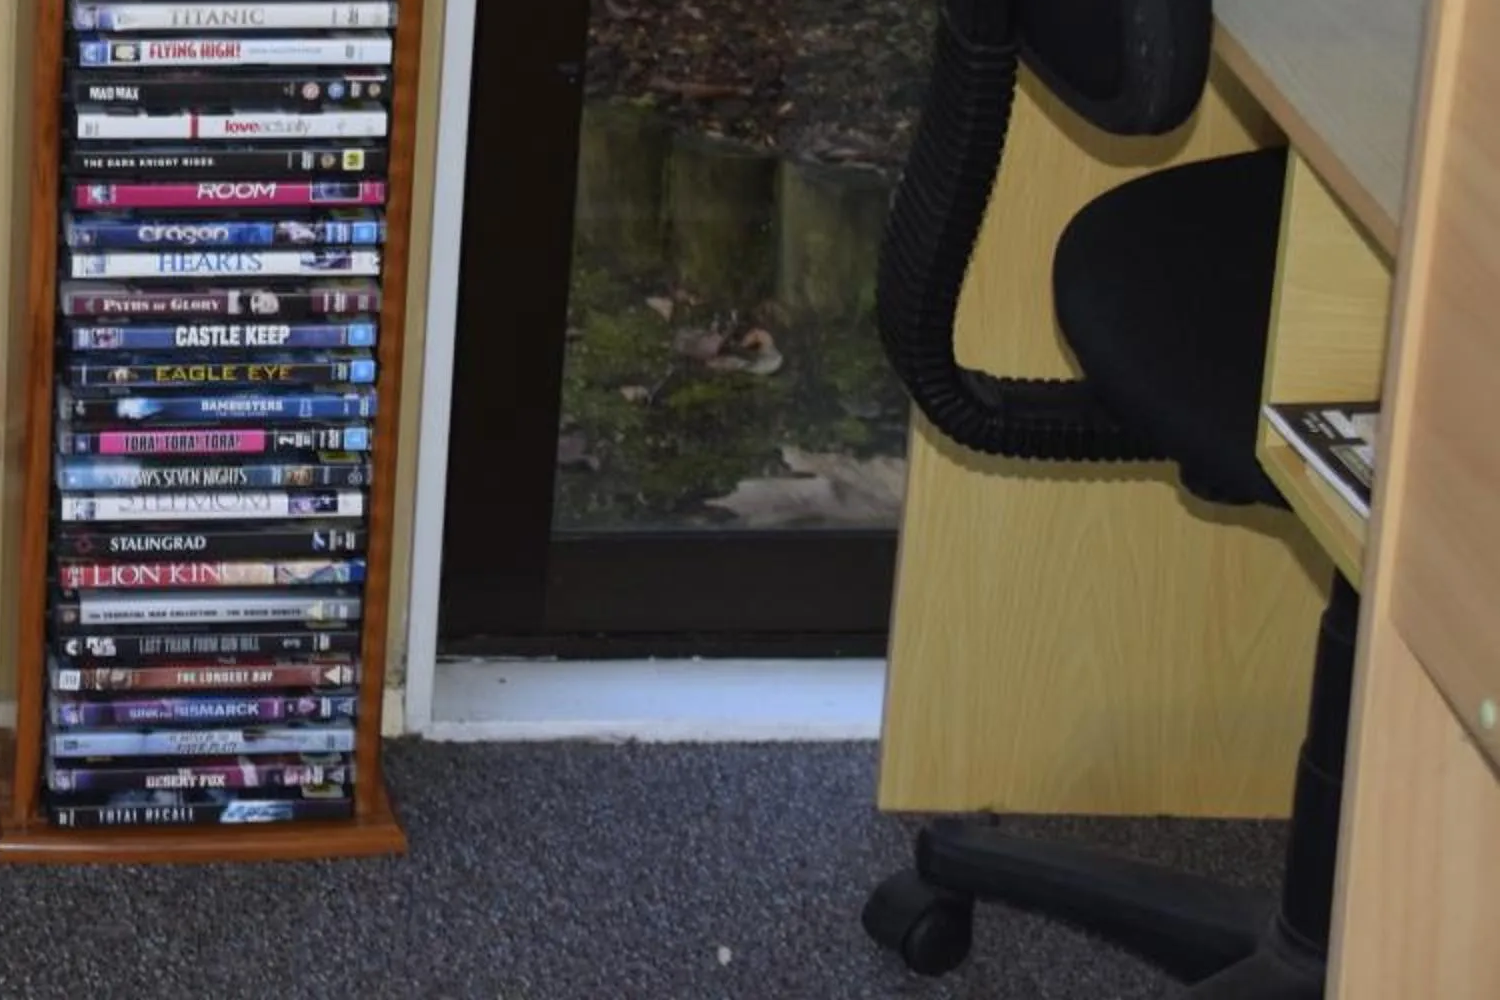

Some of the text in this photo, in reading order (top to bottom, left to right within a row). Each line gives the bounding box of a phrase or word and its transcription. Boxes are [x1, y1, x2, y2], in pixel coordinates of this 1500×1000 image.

[168, 8, 265, 25] TITANIC
[149, 44, 197, 59] FLYING
[200, 43, 241, 58] HIGH!
[89, 86, 139, 101] MAD MAX
[84, 158, 102, 168] THE
[107, 157, 136, 167] DARK
[139, 157, 179, 167] KNIGHT
[197, 183, 277, 199] ROOM
[157, 253, 263, 273] HEARTS
[103, 299, 149, 312] PATHS
[171, 298, 220, 311] GLORY
[175, 325, 291, 346] CASTLE KEEP
[155, 364, 293, 382] EAGLE EYE
[163, 469, 248, 486] SEVEN NIGHTS
[110, 536, 207, 551] STALINGRAD
[92, 565, 161, 586] LION
[173, 703, 260, 718] BISMARCK
[99, 808, 194, 824] TOTAL RECALL
